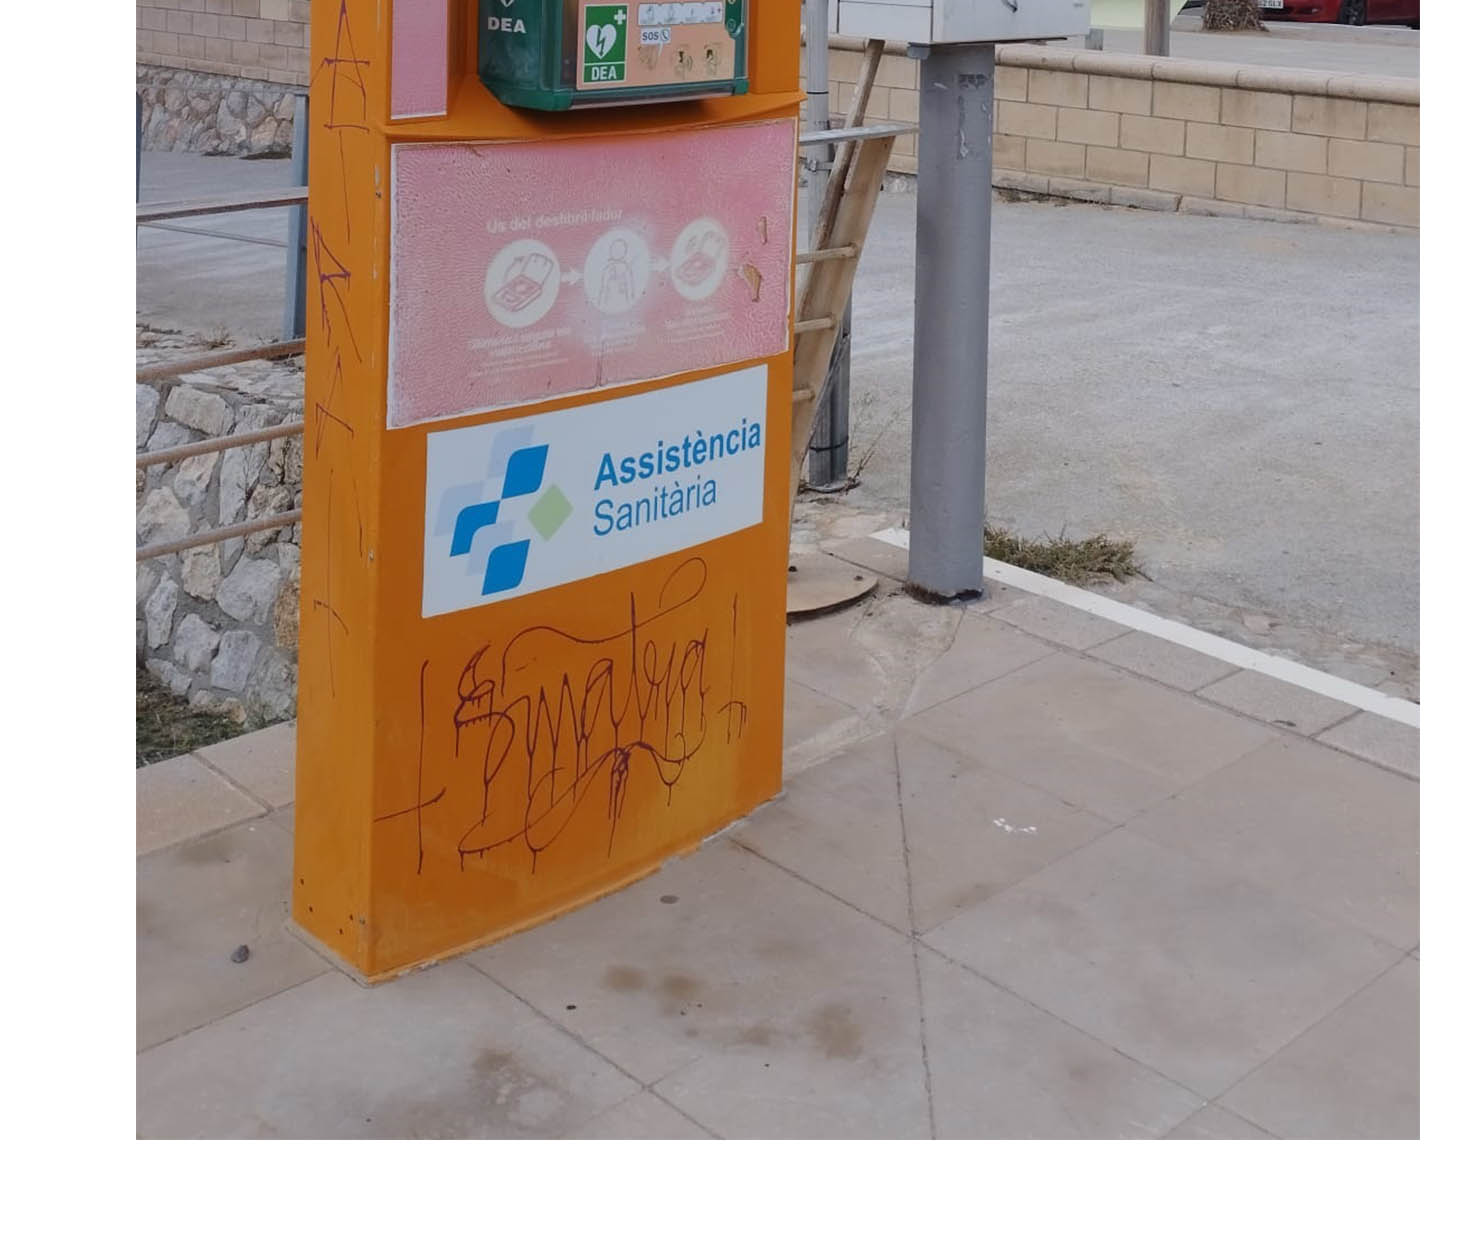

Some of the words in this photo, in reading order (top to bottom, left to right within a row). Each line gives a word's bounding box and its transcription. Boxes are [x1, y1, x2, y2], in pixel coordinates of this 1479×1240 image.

[488, 17, 527, 34] DEA
[642, 31, 660, 41] SOS
[591, 66, 617, 81] DEA
[593, 417, 761, 491] Assistència
[592, 478, 718, 536] Sanitària
